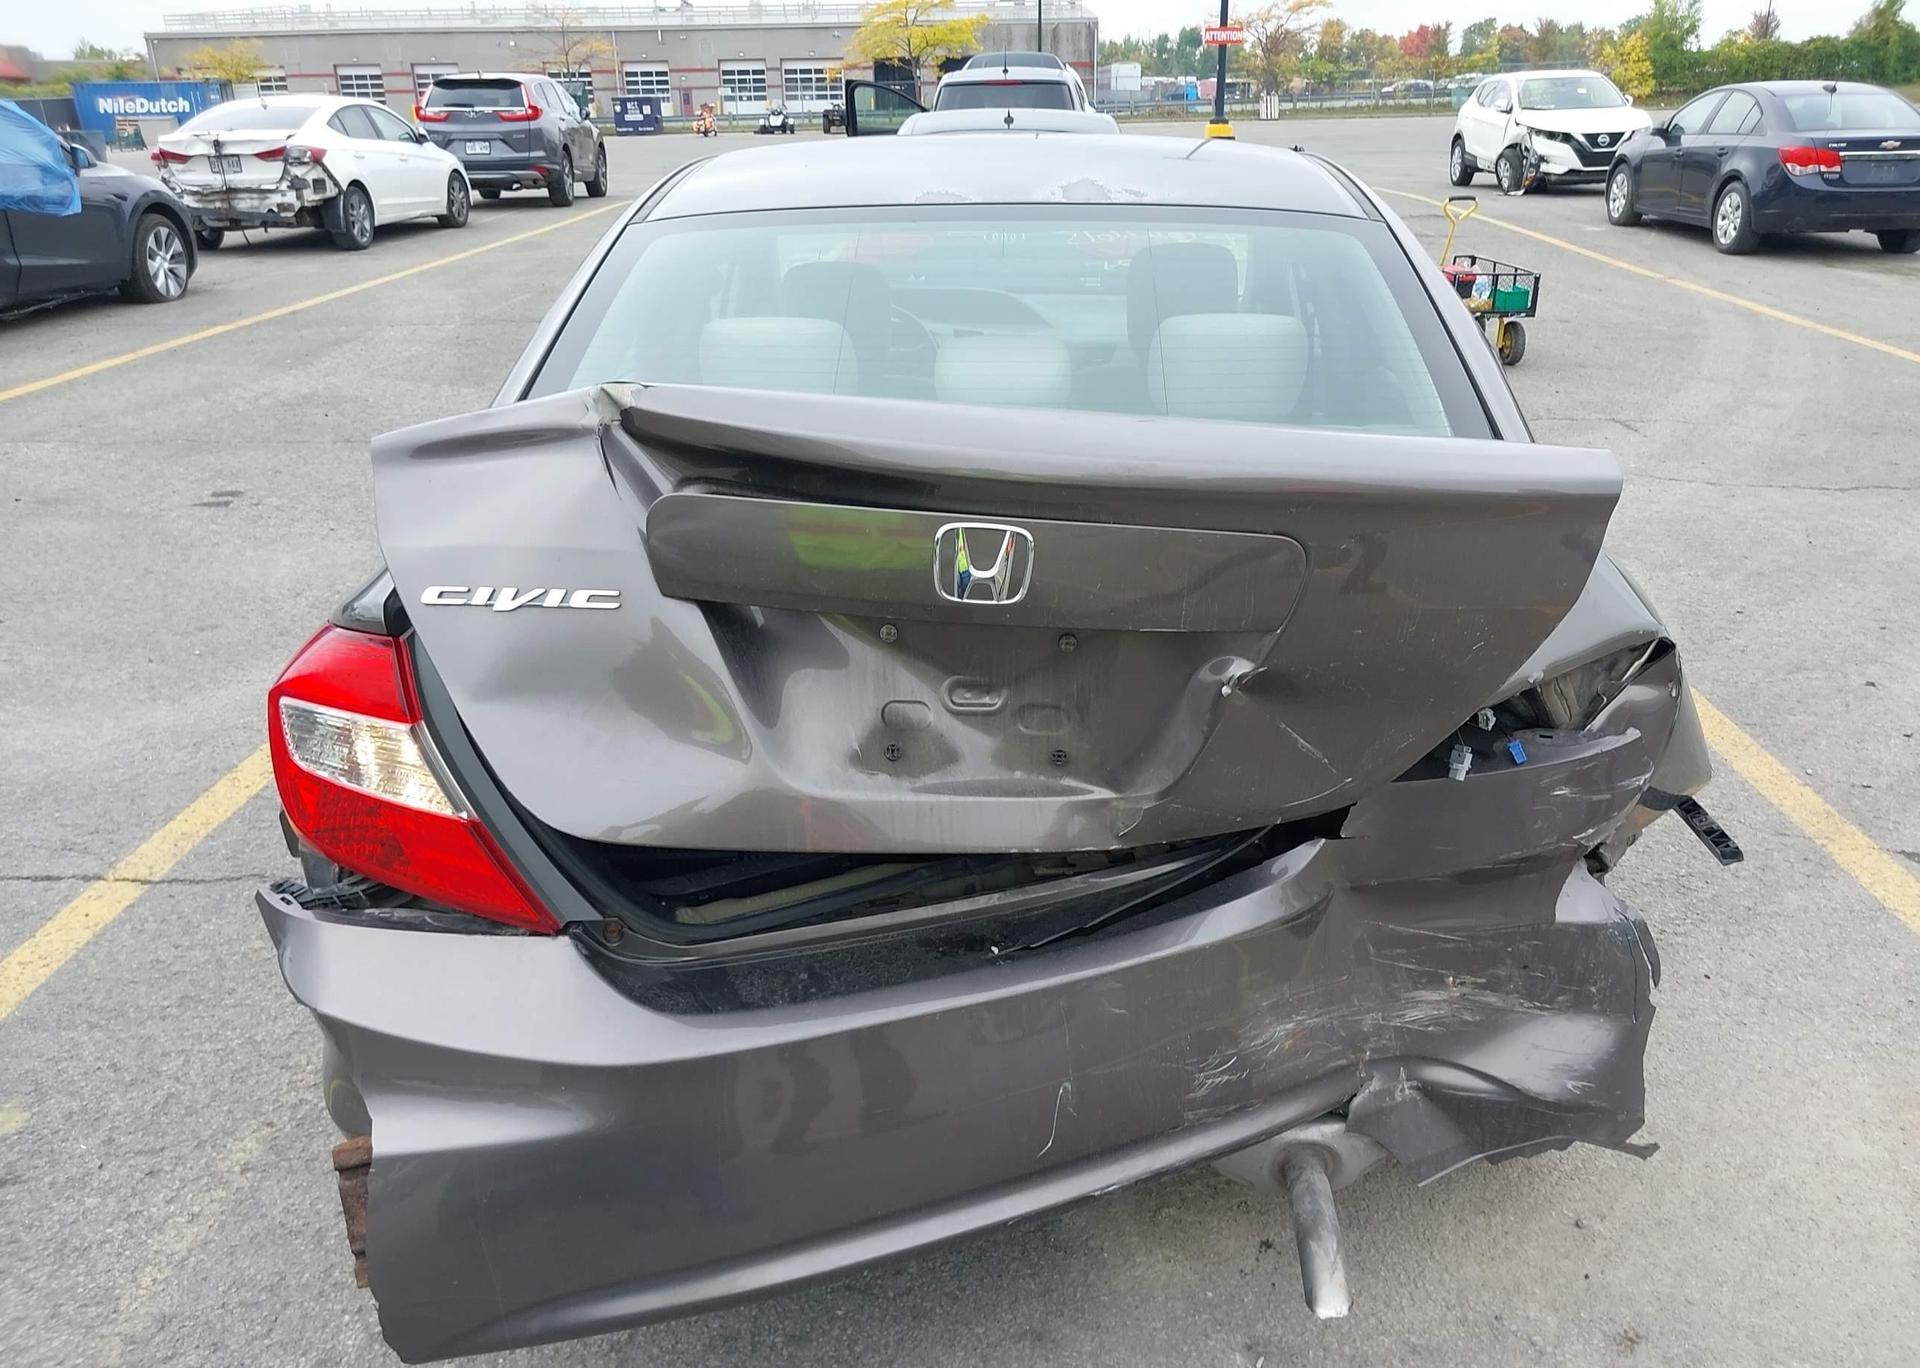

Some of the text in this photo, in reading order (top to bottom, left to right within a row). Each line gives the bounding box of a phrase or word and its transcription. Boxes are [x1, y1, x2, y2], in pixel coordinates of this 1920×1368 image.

[1205, 30, 1243, 41] ATTENTION
[98, 97, 191, 114] NileDutch
[420, 585, 621, 612] CIVIC
